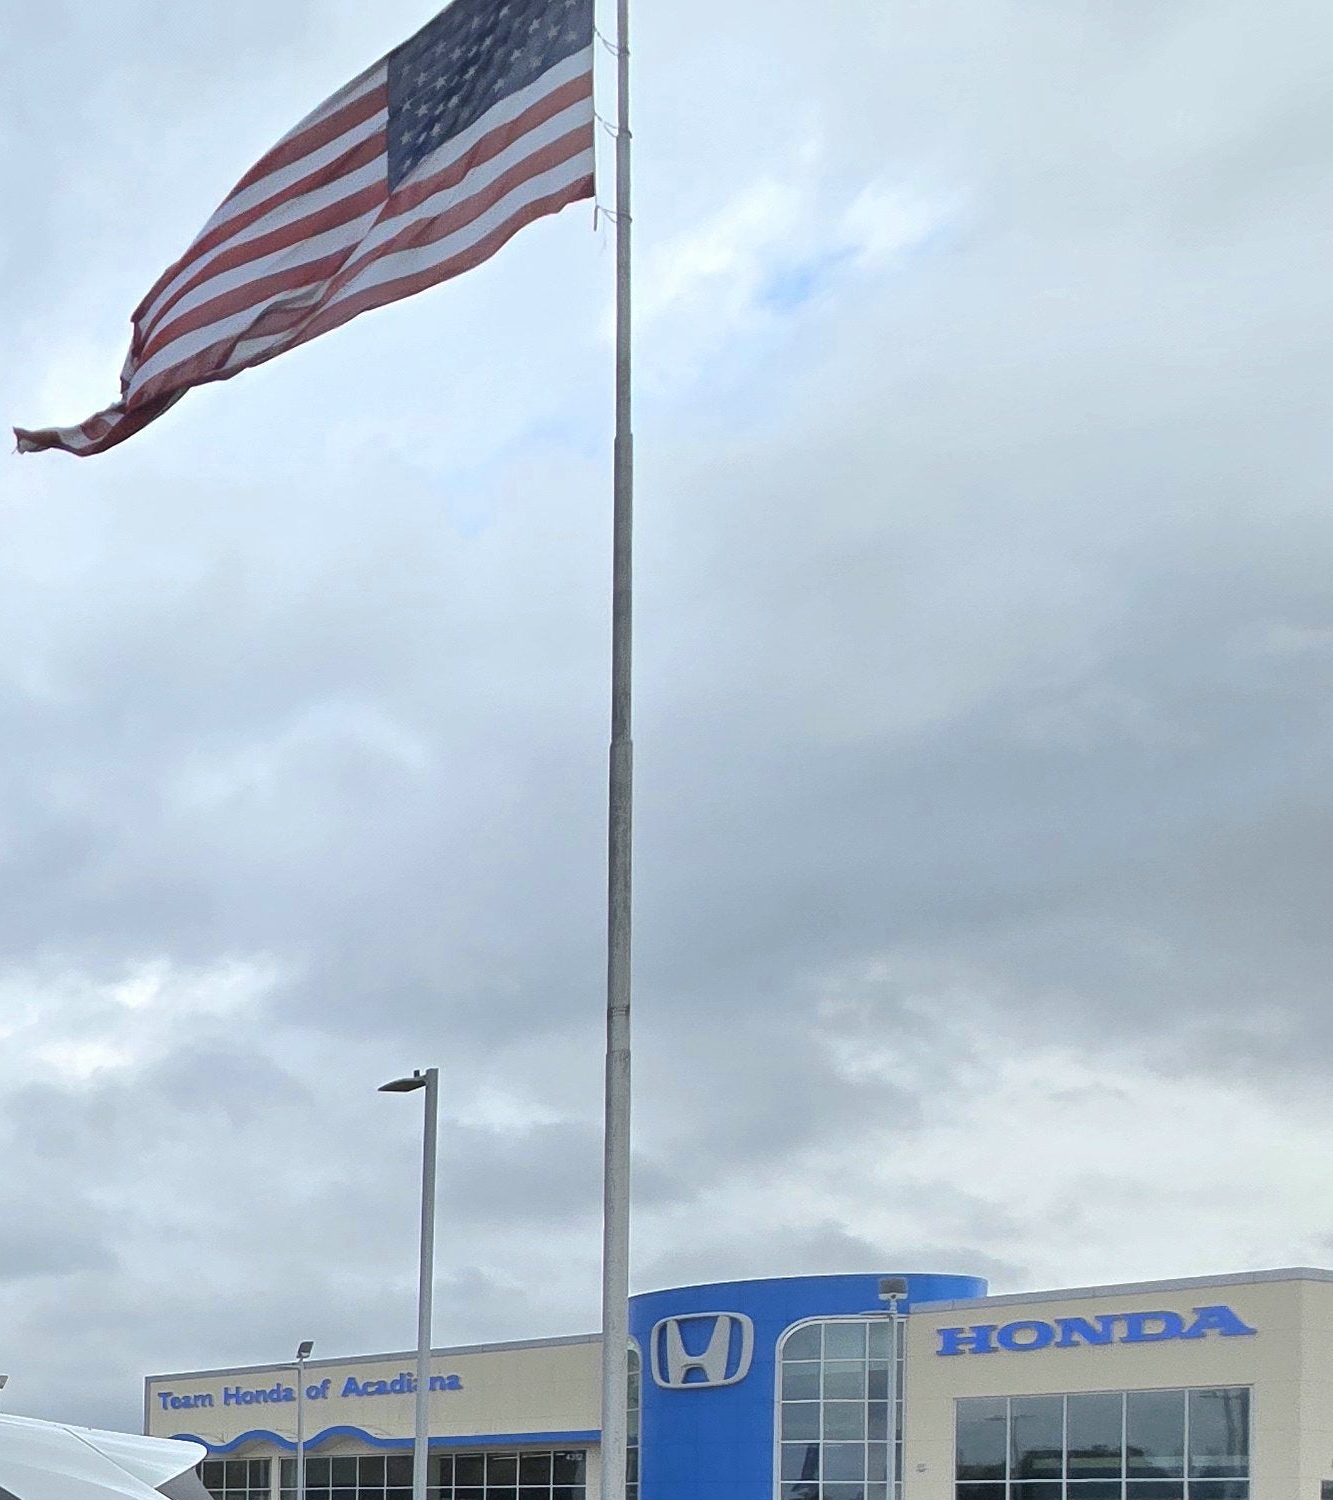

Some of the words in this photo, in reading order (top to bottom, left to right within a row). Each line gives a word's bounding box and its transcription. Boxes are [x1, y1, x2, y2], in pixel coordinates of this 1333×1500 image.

[936, 1305, 1257, 1356] HONDA
[157, 1391, 215, 1411] Team
[223, 1382, 297, 1407] Honda
[305, 1378, 332, 1400] of
